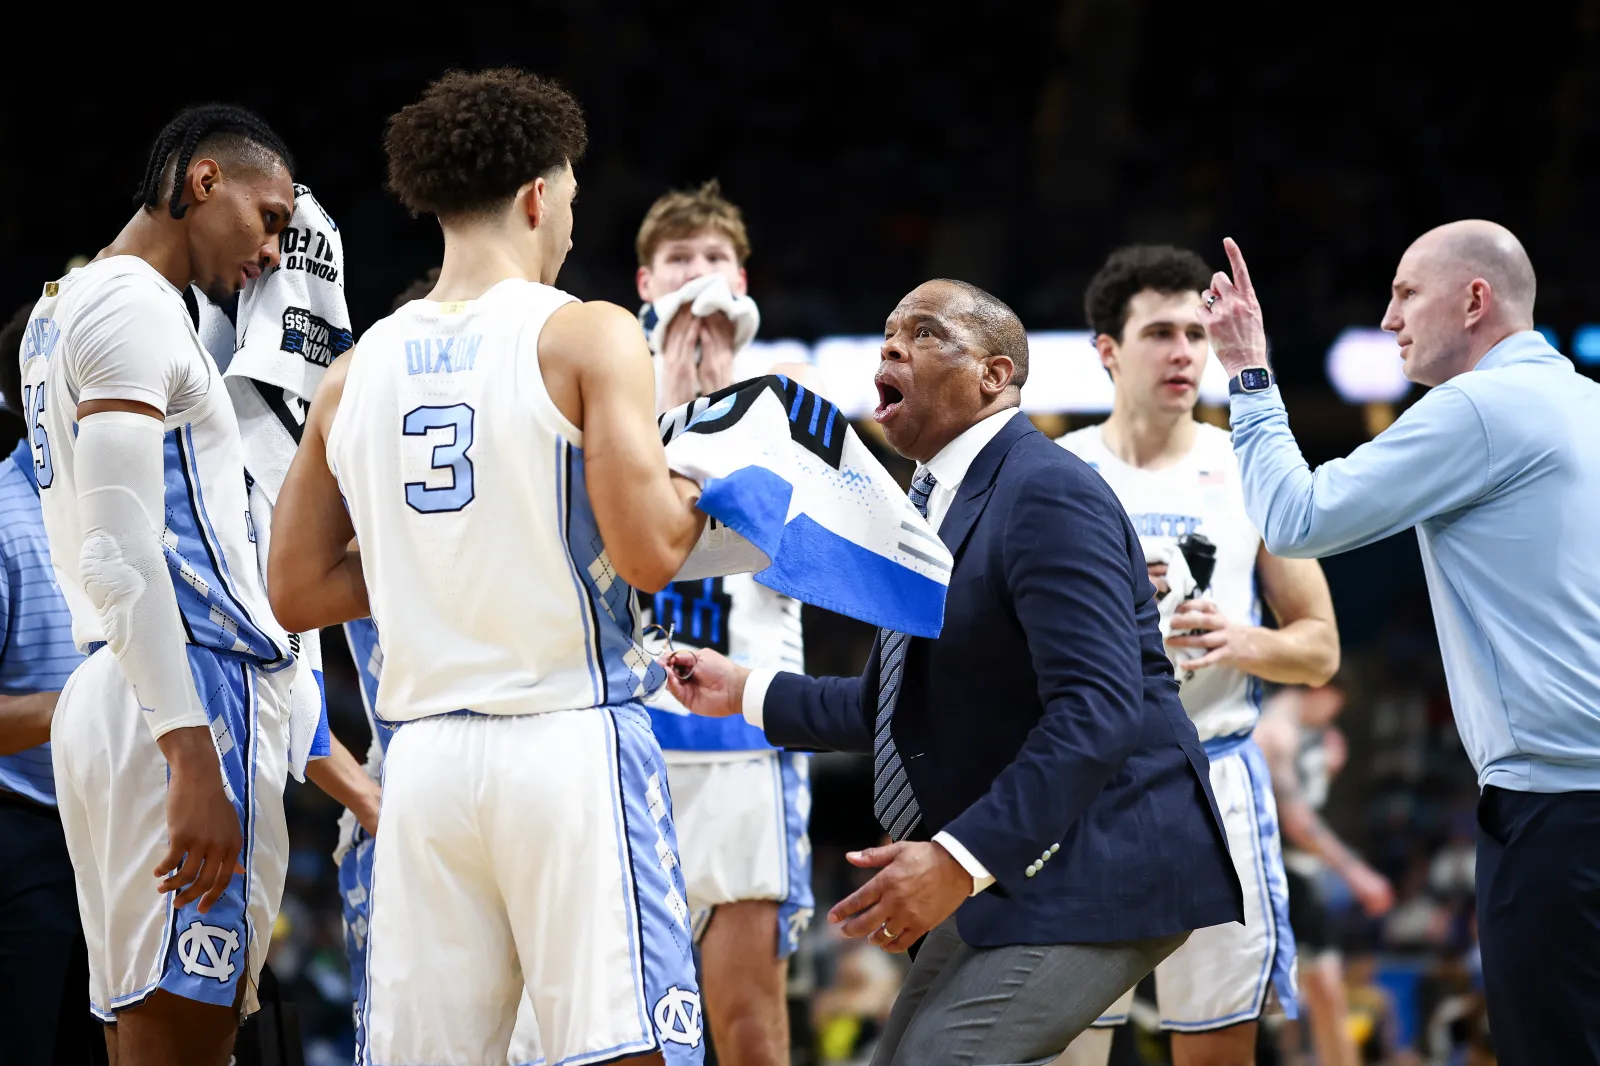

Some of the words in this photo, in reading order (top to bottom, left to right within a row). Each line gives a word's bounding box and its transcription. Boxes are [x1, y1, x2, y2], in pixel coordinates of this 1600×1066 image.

[286, 255, 304, 270] TO
[305, 258, 338, 283] ROAD
[404, 334, 483, 376] DIXON
[402, 402, 475, 514] 3
